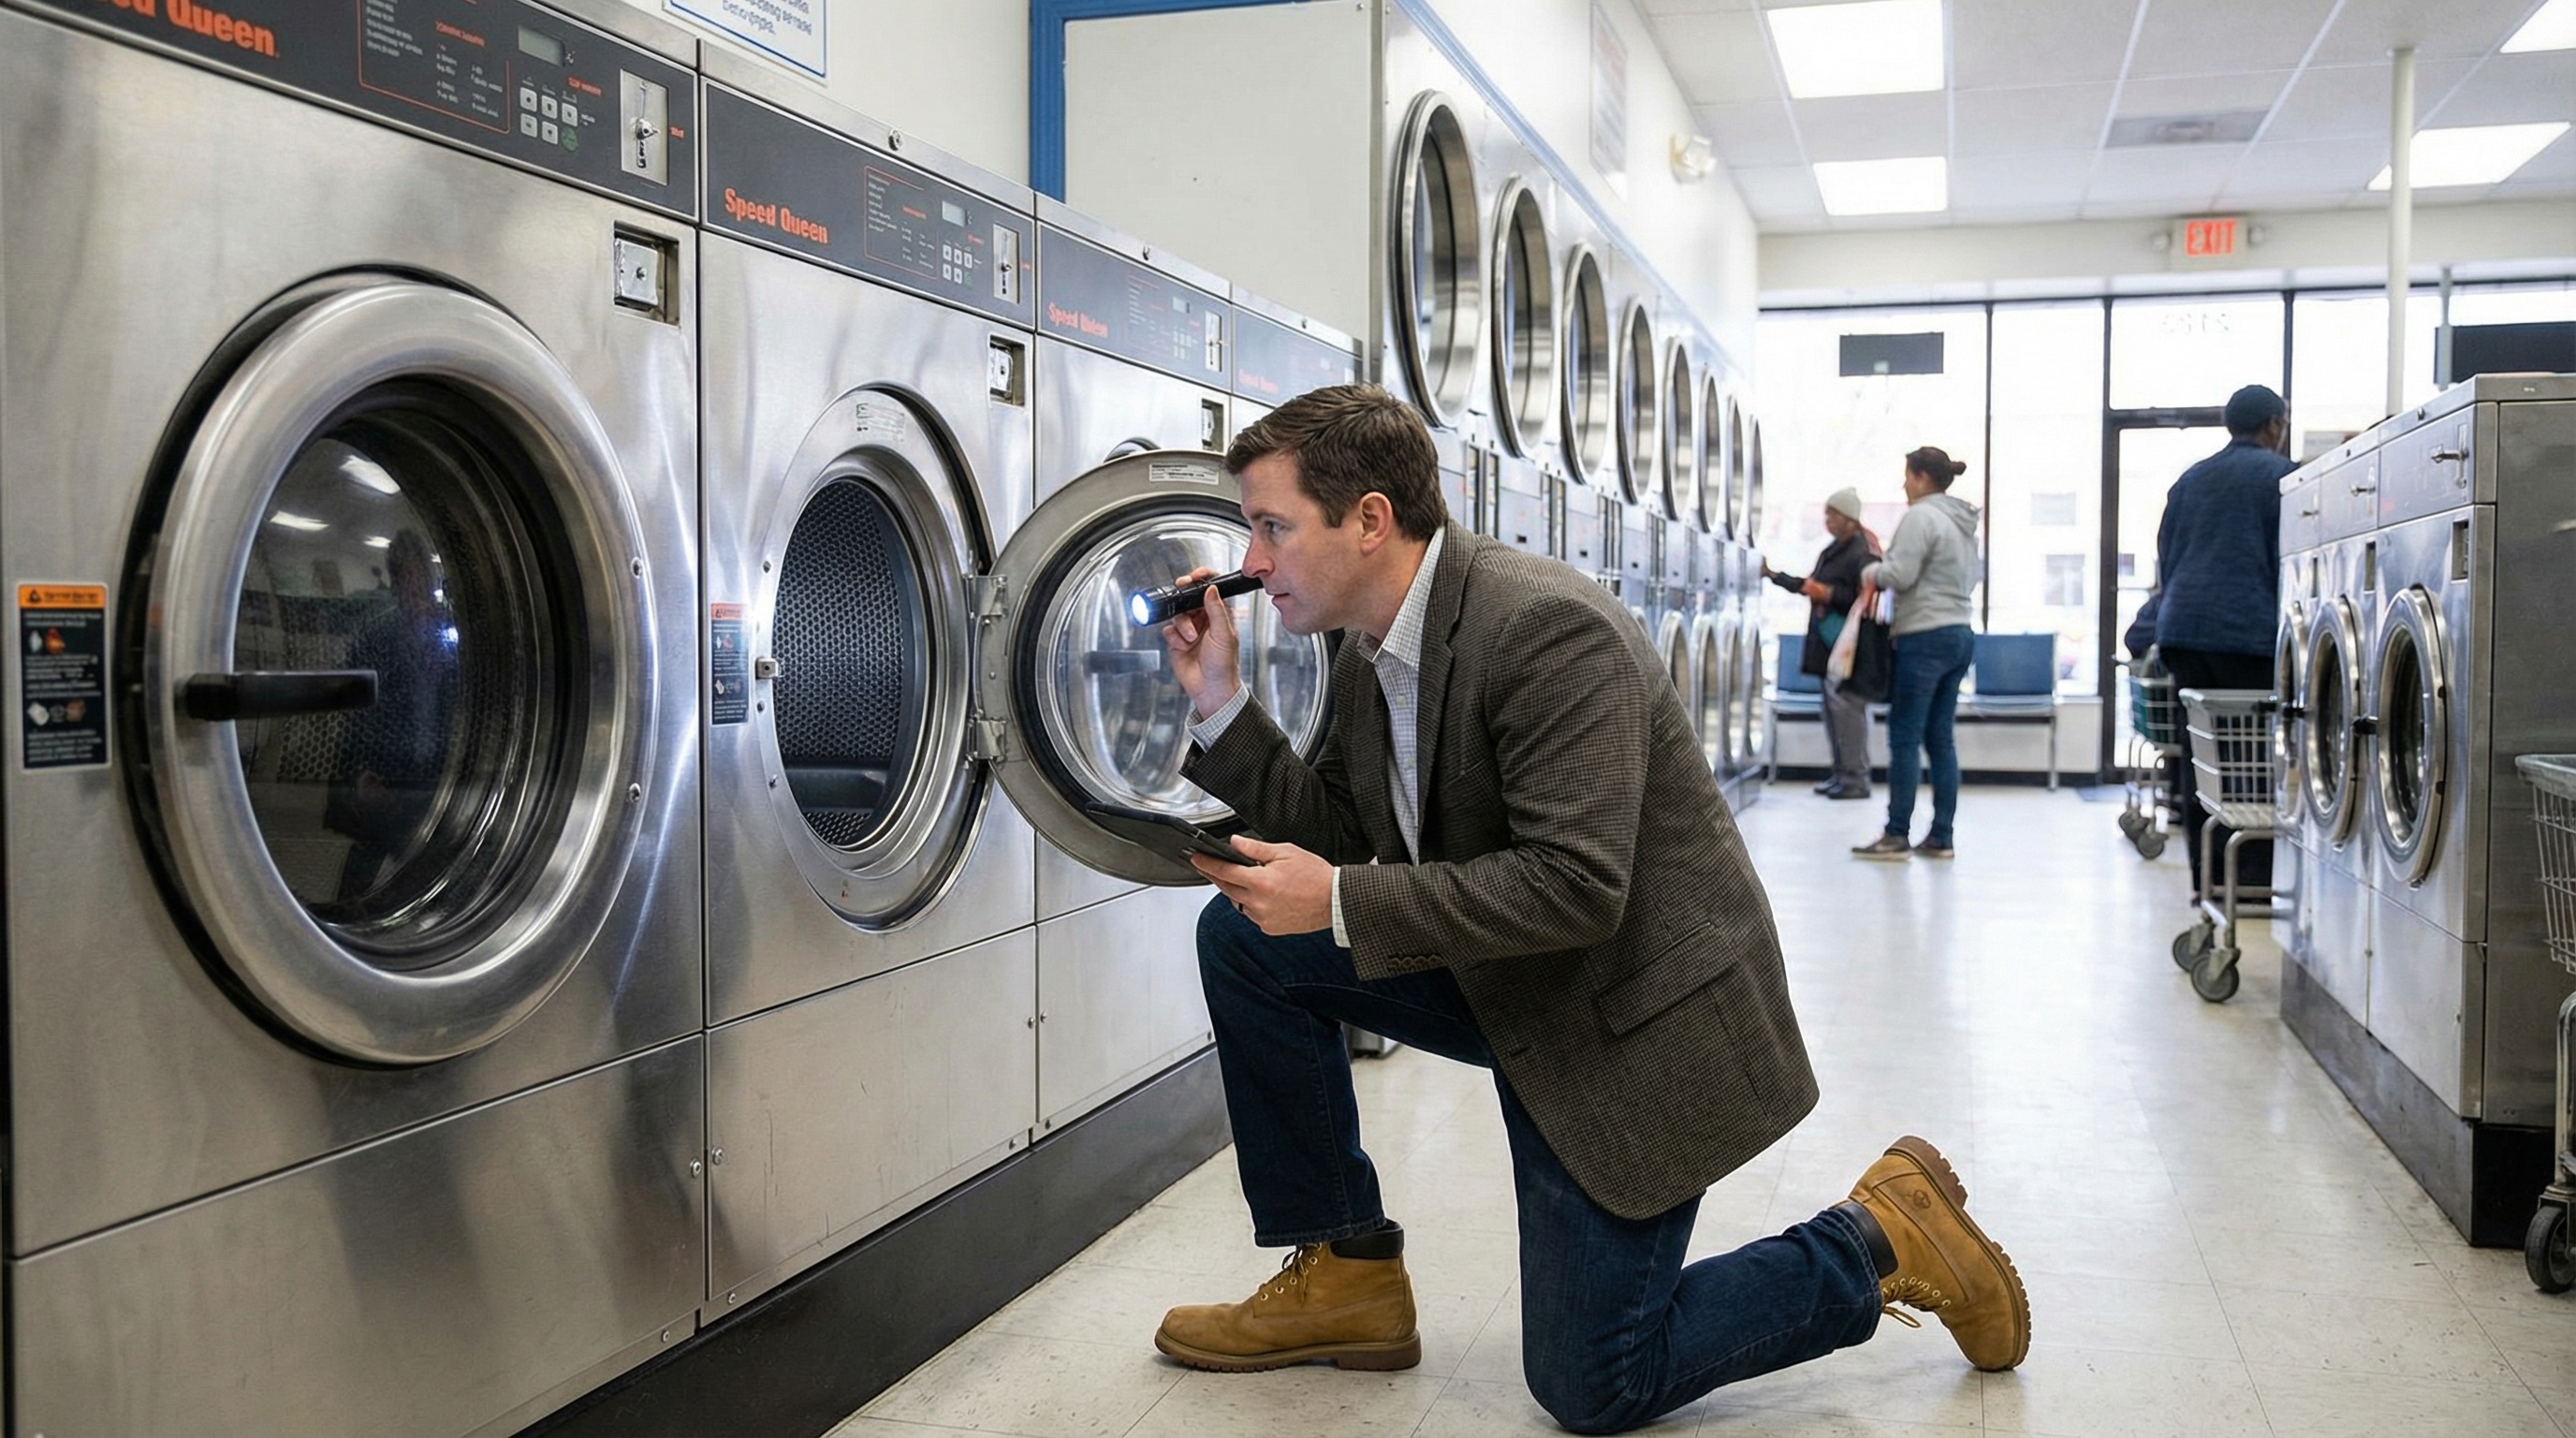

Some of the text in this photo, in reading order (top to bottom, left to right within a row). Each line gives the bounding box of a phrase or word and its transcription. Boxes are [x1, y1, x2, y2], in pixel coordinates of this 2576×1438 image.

[724, 187, 827, 243] Speed Queen
[2185, 219, 2236, 256] EXIT
